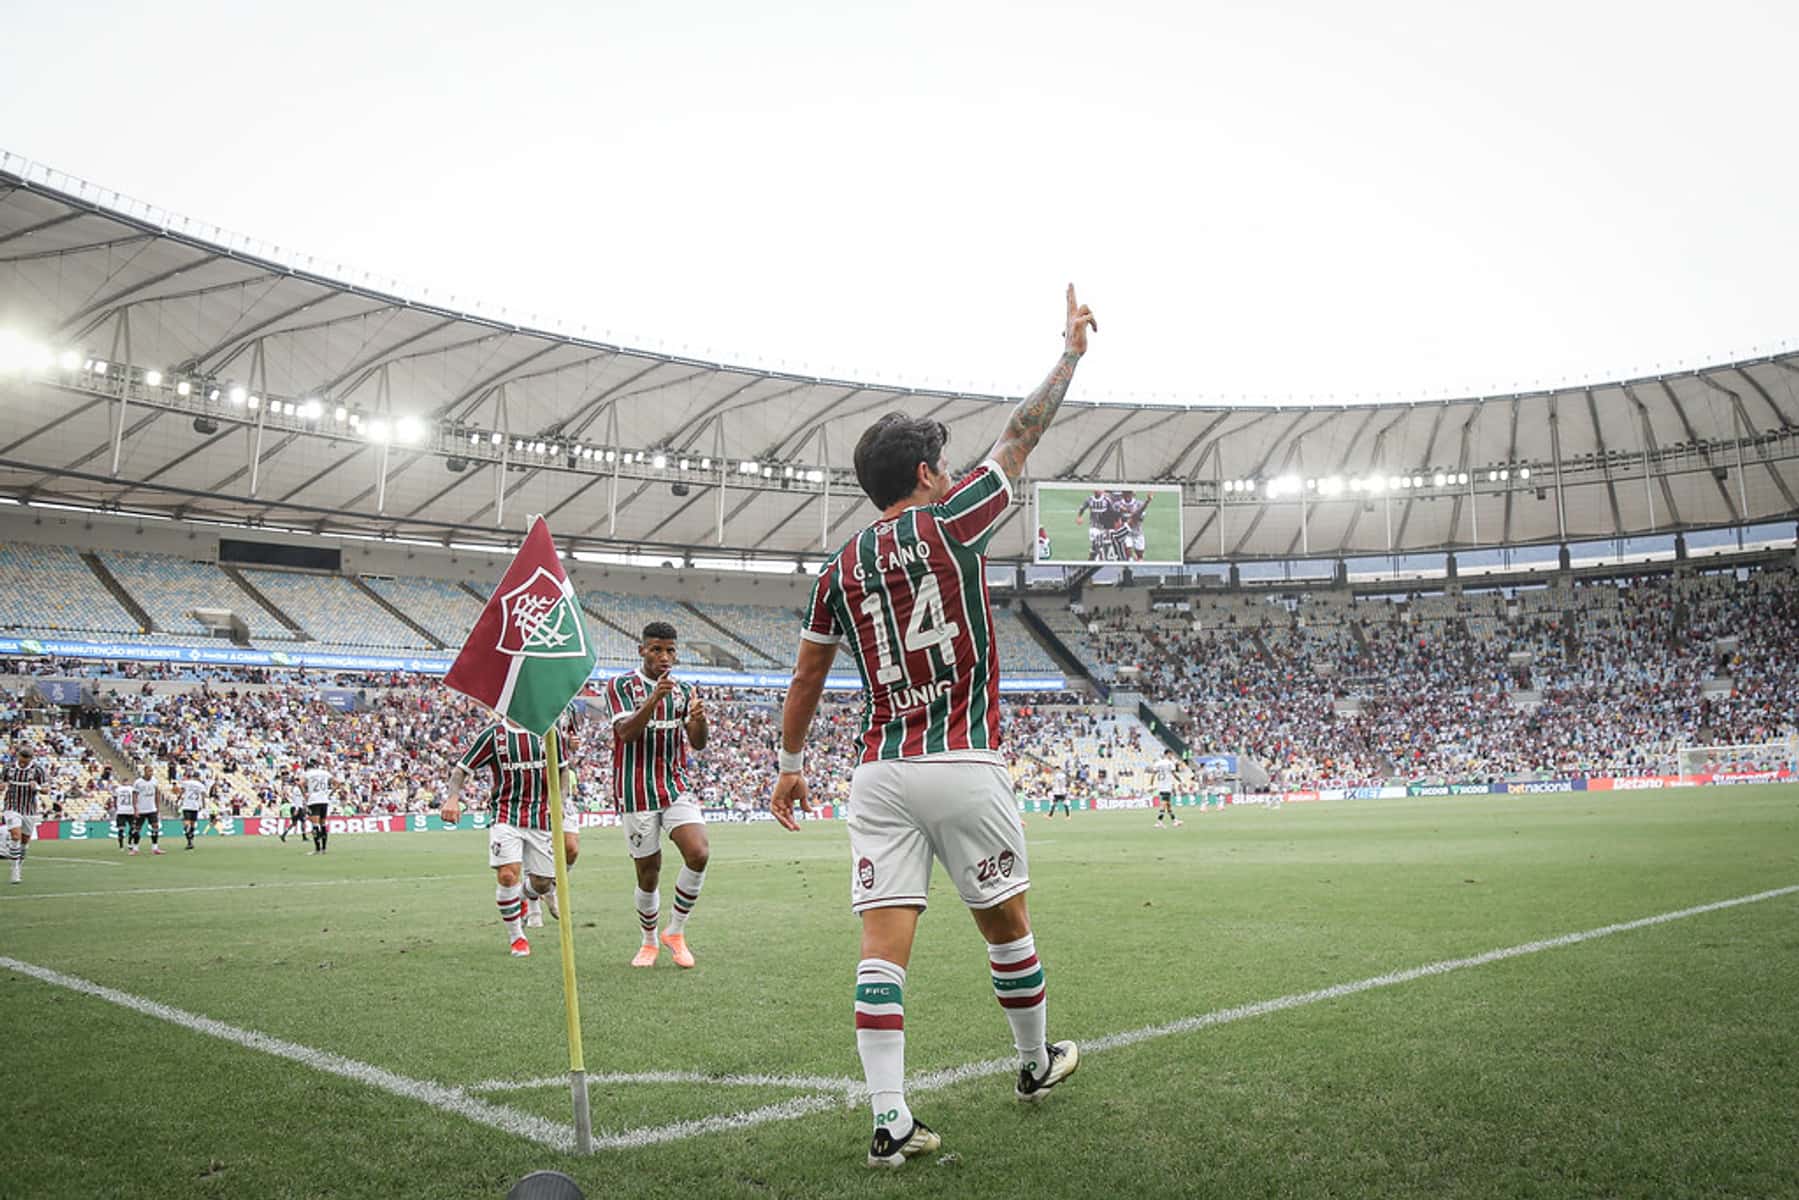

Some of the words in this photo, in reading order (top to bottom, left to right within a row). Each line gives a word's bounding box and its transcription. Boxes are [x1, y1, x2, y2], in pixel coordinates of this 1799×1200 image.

[853, 567, 873, 581] G.
[875, 541, 931, 573] CANO
[860, 573, 960, 685] 14
[1508, 781, 1572, 794] betnacional
[1614, 777, 1664, 790] Betano
[977, 856, 999, 881] Zé
[865, 987, 890, 996] FFC
[876, 1109, 899, 1126] RO
